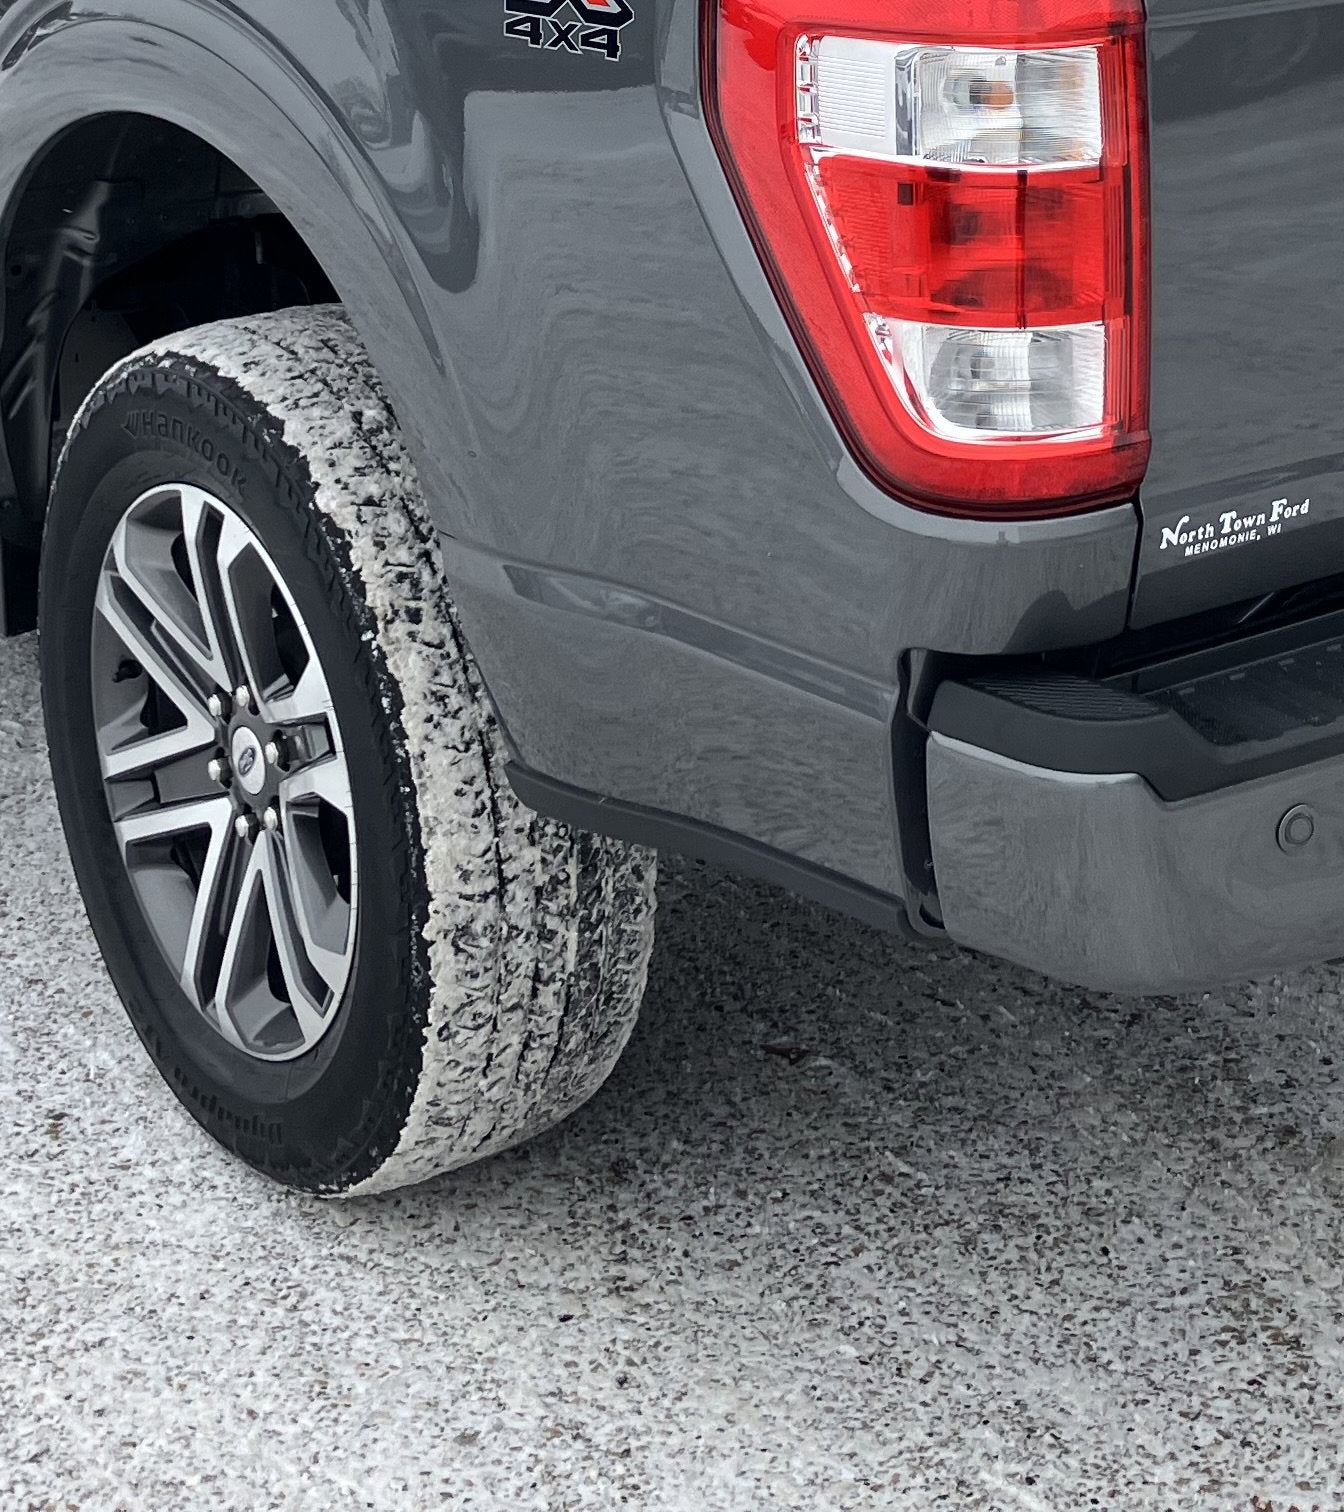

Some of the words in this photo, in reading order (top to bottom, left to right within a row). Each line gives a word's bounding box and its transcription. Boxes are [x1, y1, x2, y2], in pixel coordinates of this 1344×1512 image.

[1159, 515, 1215, 550] North
[1219, 510, 1266, 534] Town
[1269, 498, 1310, 522] Ford
[1267, 523, 1282, 536] WI
